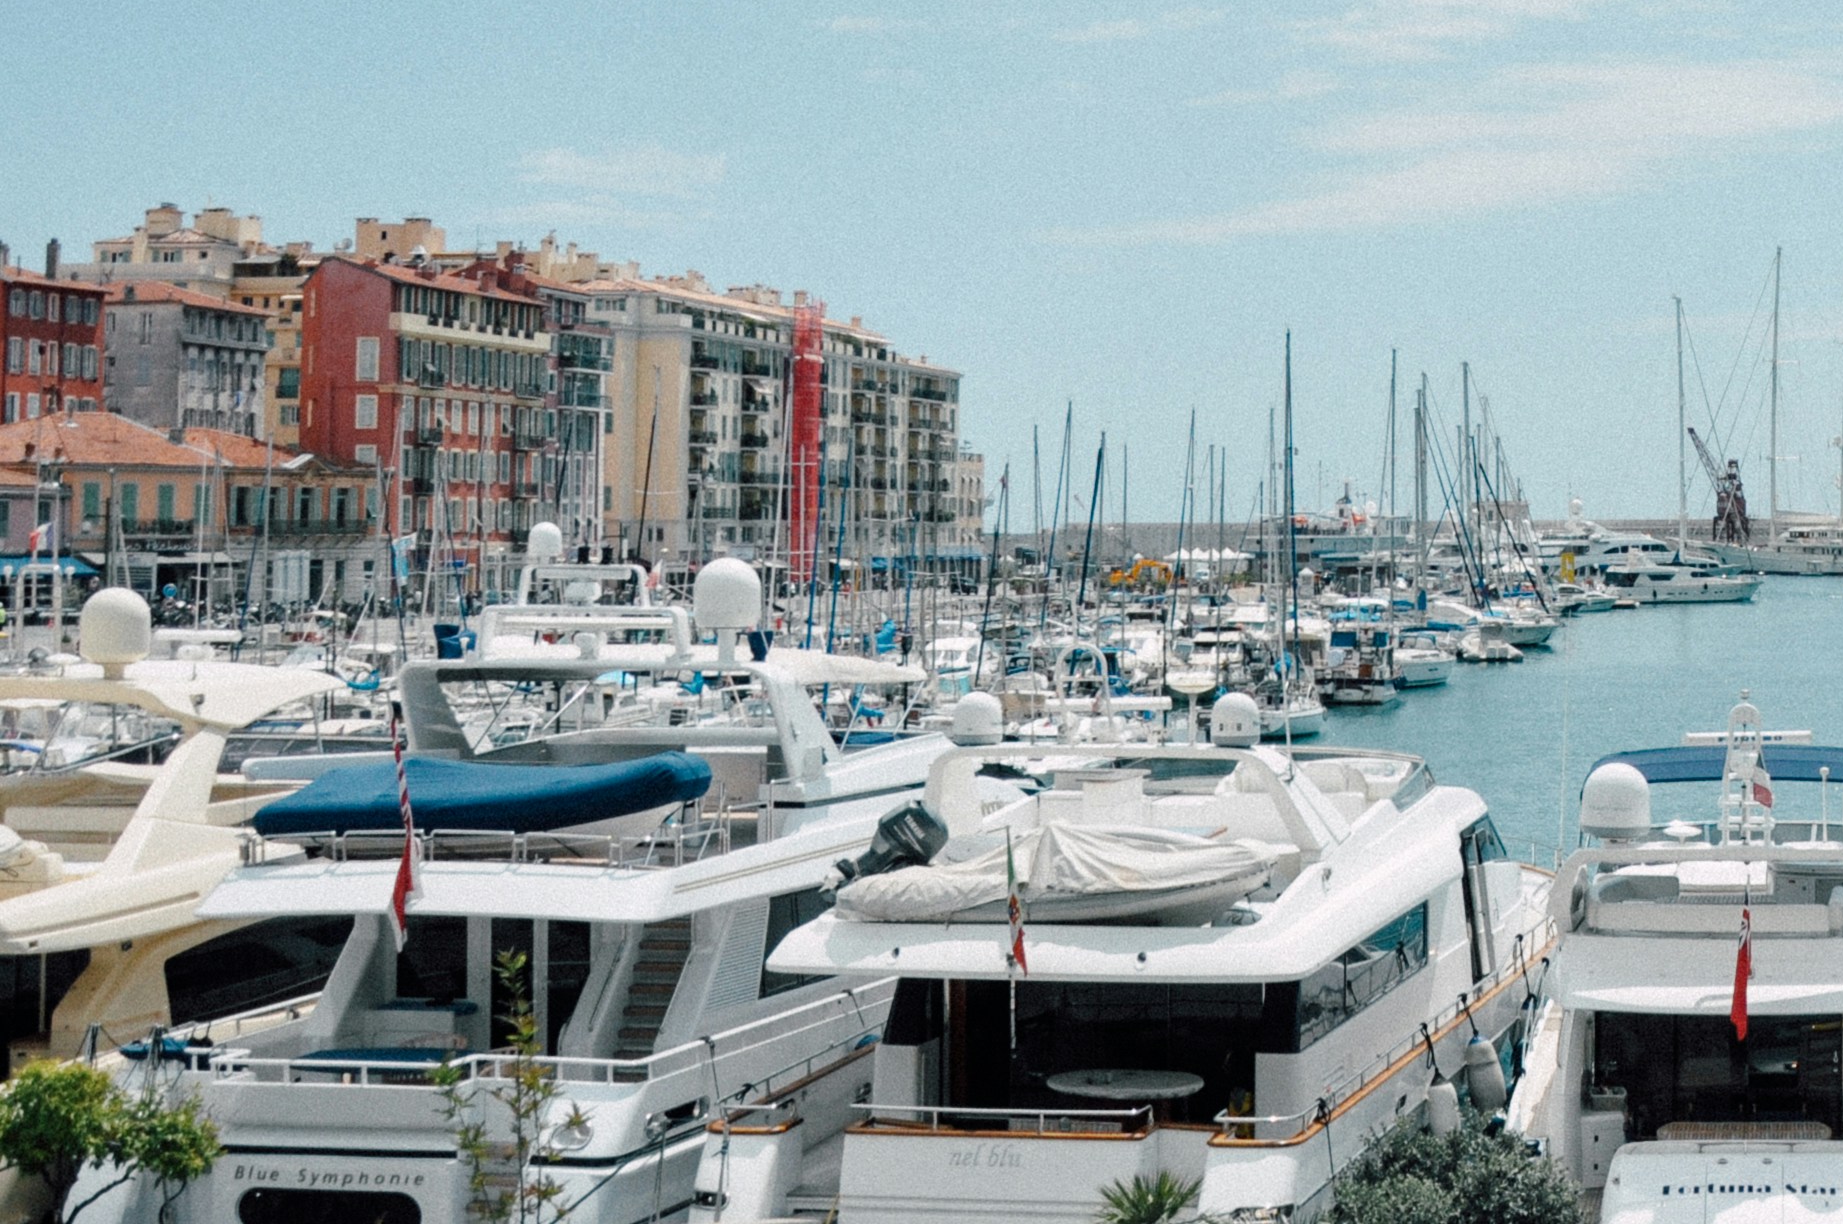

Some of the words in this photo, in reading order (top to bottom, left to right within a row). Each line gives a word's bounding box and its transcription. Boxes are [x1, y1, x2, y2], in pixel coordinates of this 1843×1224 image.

[948, 1142, 986, 1167] nel
[987, 1143, 1023, 1168] blu
[234, 1165, 280, 1181] Blue
[297, 1168, 425, 1187] Symphonie
